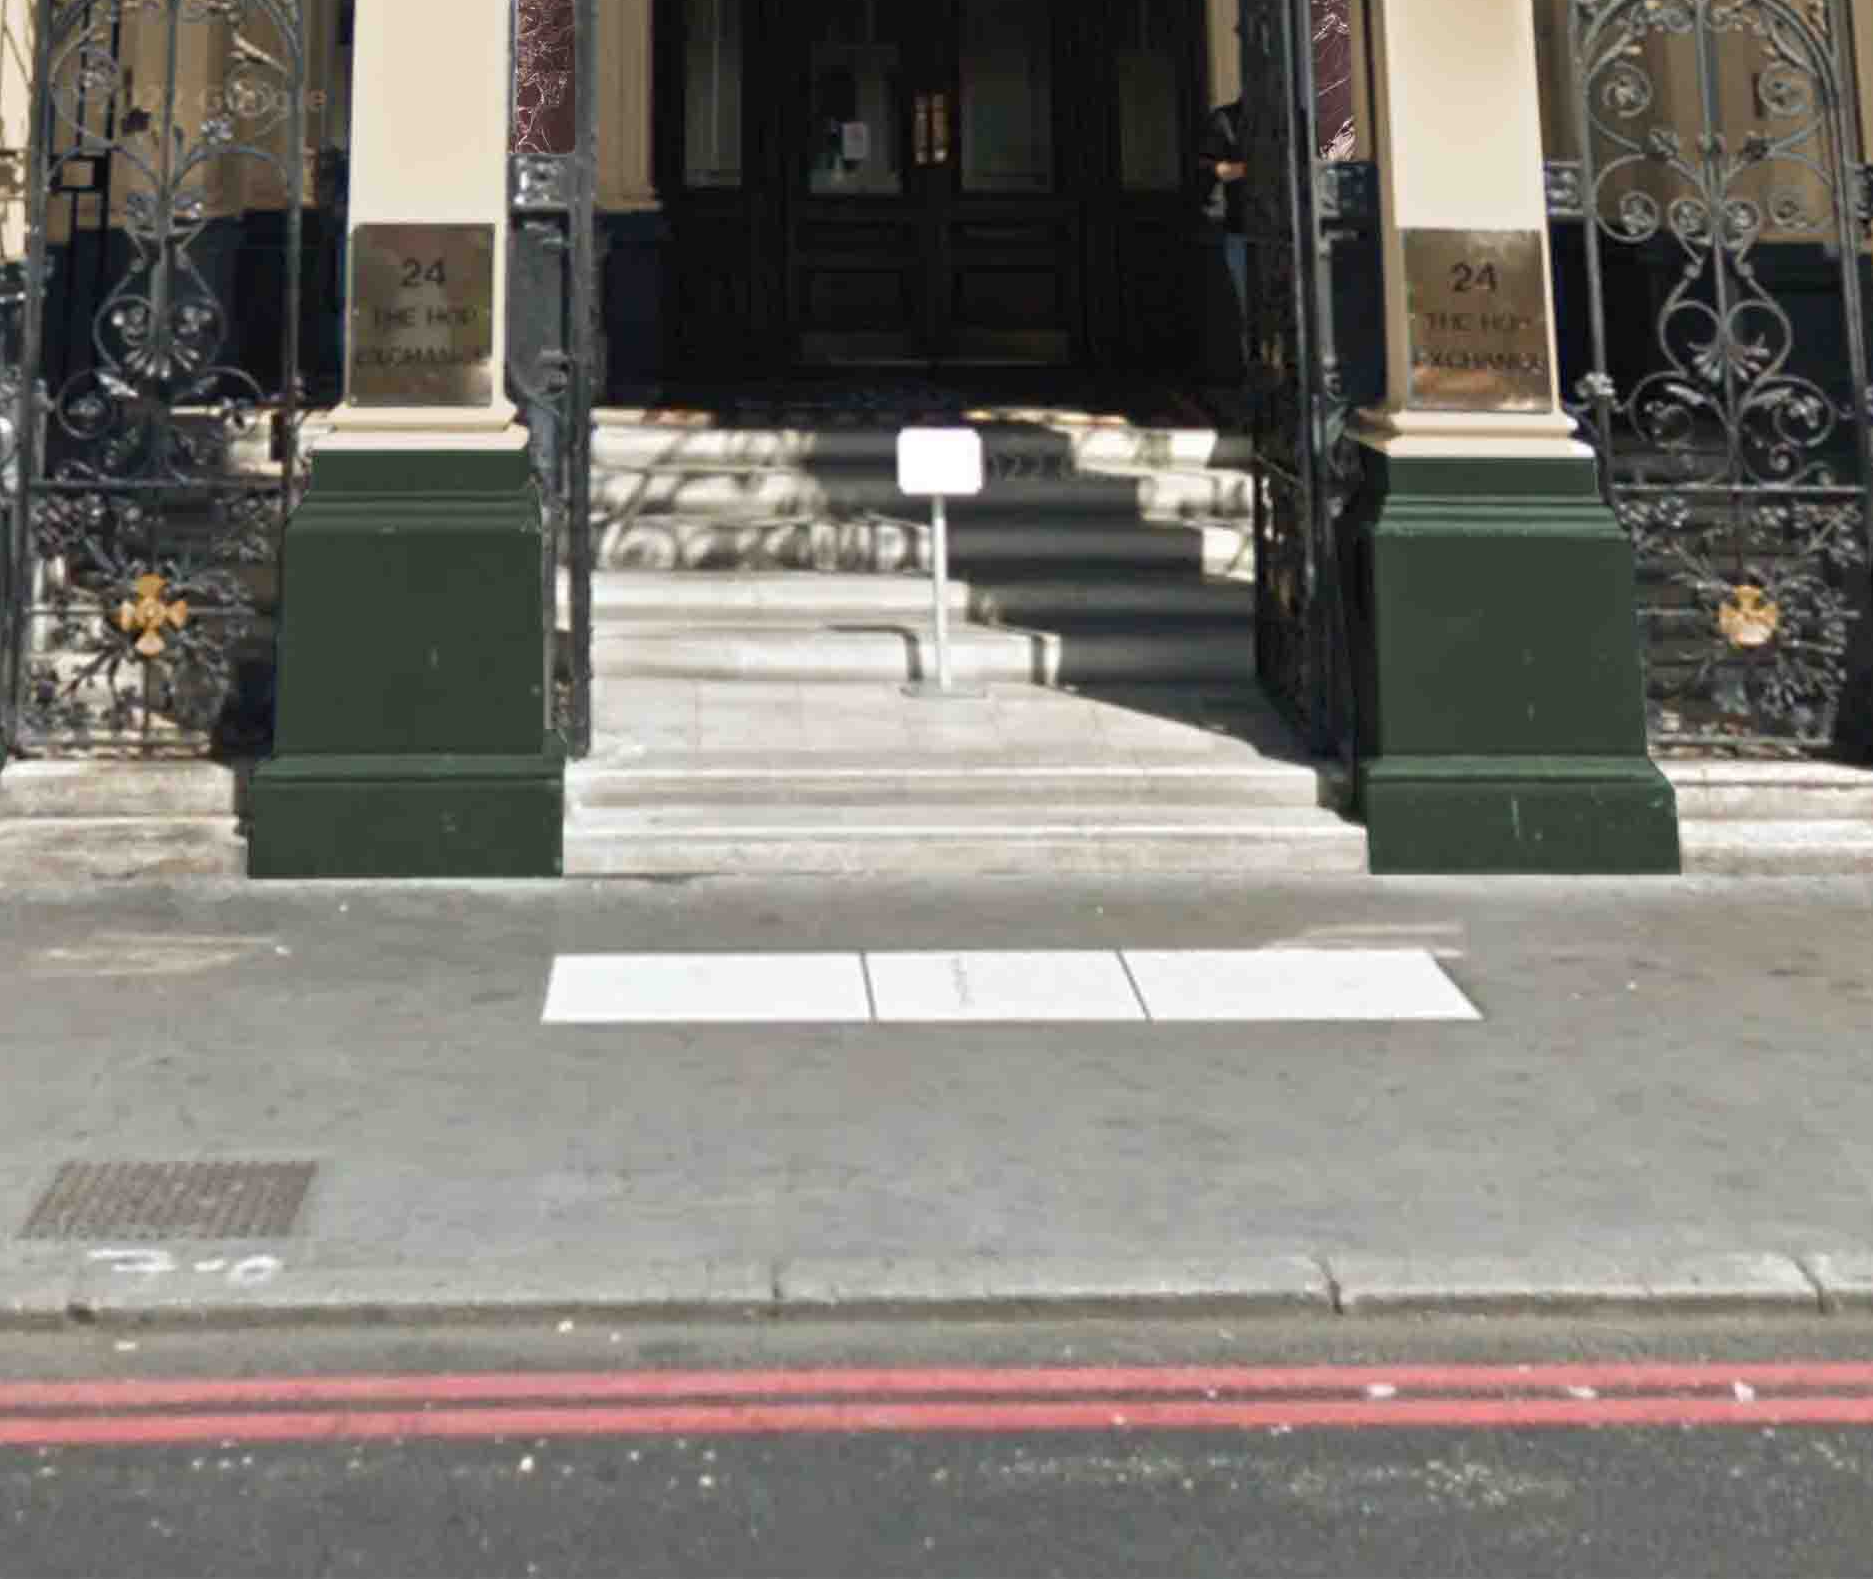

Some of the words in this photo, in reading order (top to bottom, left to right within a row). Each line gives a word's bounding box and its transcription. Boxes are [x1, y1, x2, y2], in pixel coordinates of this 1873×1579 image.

[400, 257, 446, 288] 24
[1450, 261, 1498, 293] 24
[373, 306, 416, 328] THE
[1425, 312, 1472, 333] THE
